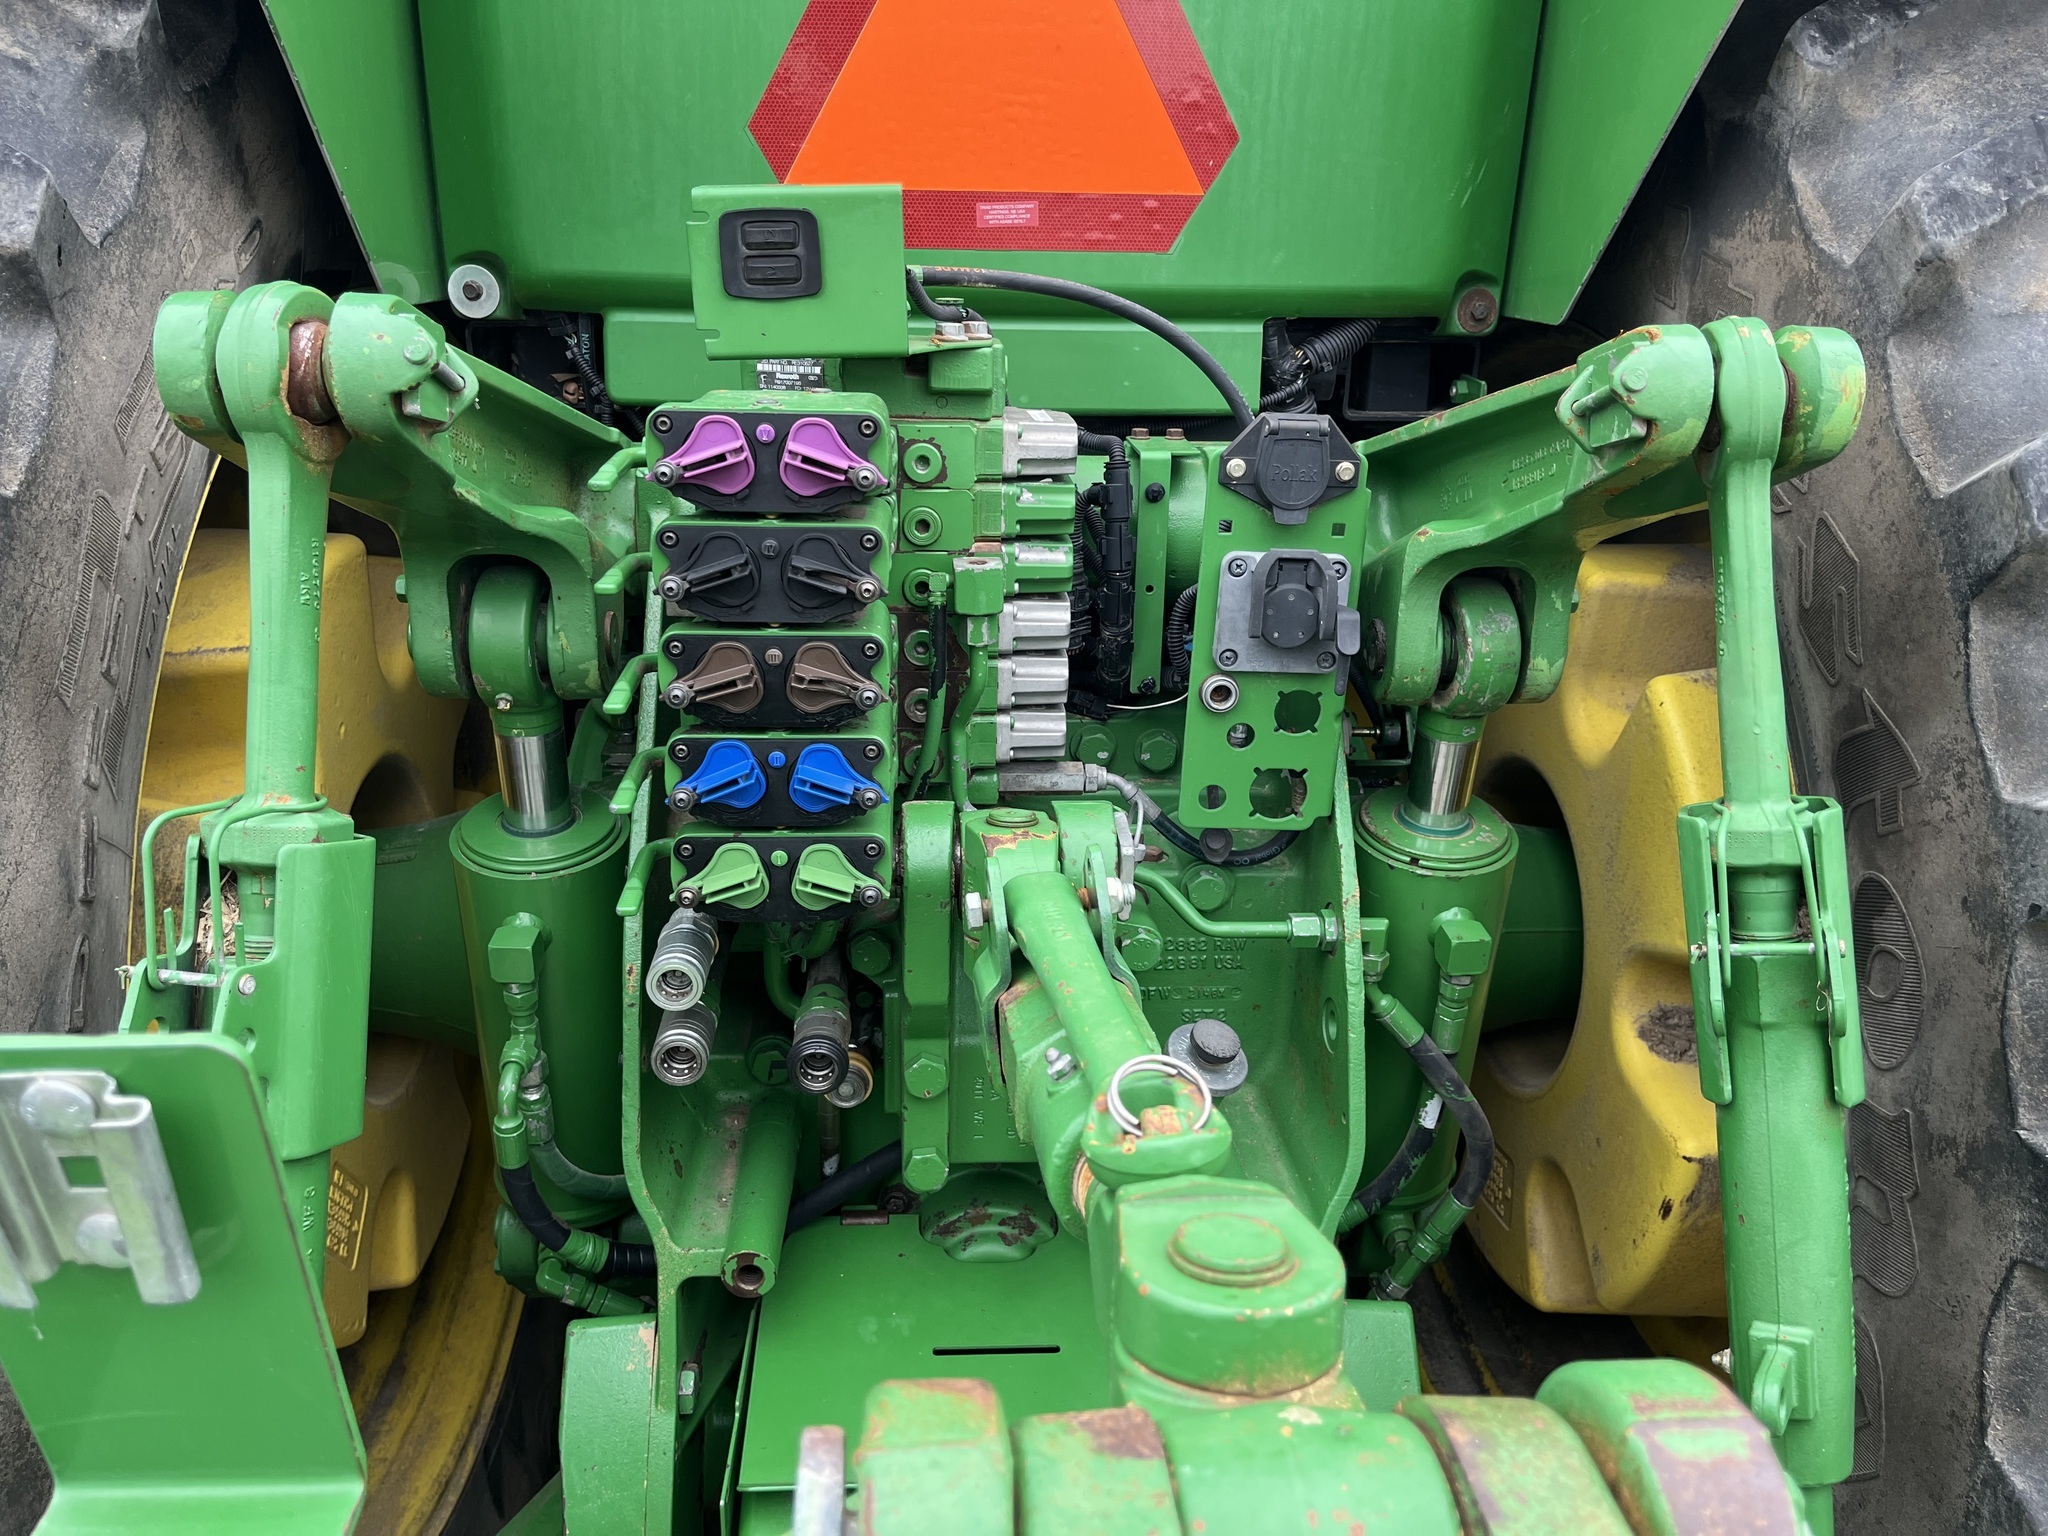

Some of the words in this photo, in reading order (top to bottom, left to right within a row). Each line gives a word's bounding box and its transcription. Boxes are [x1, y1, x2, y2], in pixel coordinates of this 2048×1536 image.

[581, 333, 591, 365] ATON
[776, 372, 800, 380] Rexroth
[1271, 463, 1318, 482] Pollak
[1254, 846, 1281, 861] Global
[1164, 937, 1208, 952] 2882
[1213, 937, 1247, 952] RAW
[1214, 954, 1244, 971] USA
[1181, 1007, 1215, 1023] SET
